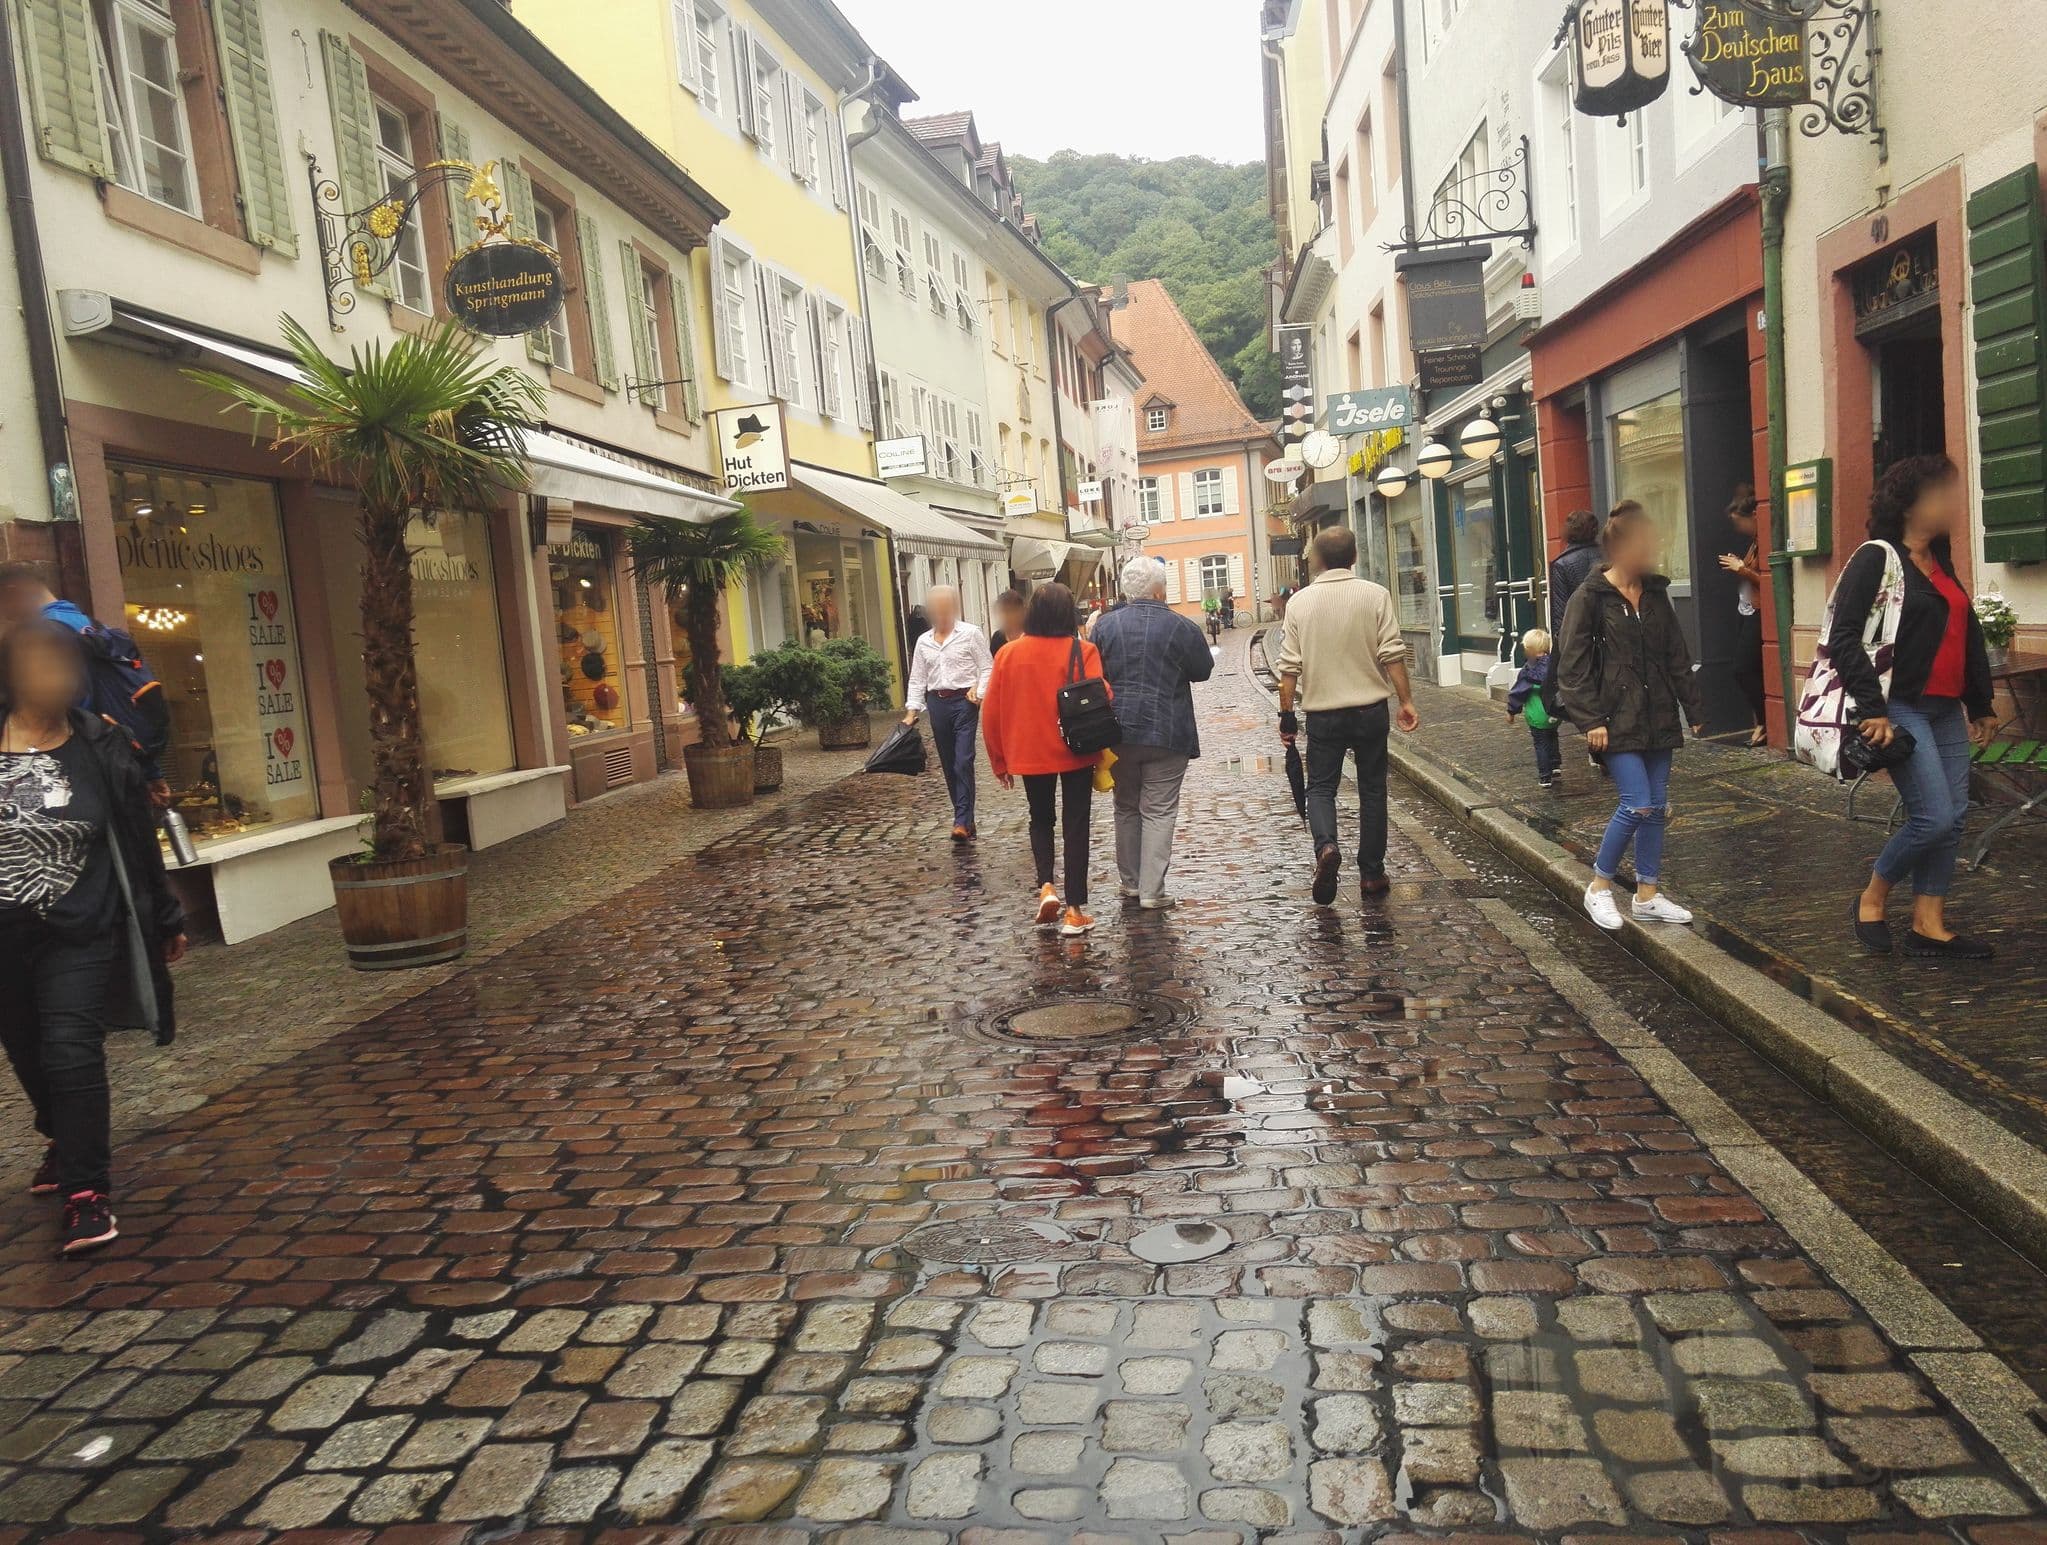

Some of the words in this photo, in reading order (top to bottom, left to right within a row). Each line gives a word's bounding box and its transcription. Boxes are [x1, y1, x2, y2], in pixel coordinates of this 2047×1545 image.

[1582, 7, 1622, 50] Ganter-
[1631, 0, 1664, 38] Ganter-
[1702, 5, 1745, 31] Zum
[1598, 32, 1622, 56] Pils
[1639, 32, 1663, 59] Bier
[1701, 26, 1799, 62] Deutschen
[1745, 57, 1804, 97] Haus
[455, 272, 553, 296] Kunsthandlung
[467, 289, 546, 312] Springmann
[725, 455, 753, 471] Hut
[726, 471, 785, 489] Dickten
[197, 533, 264, 575] shoes
[247, 592, 259, 621] I
[249, 624, 287, 646] SALE
[256, 663, 267, 690] I
[258, 692, 294, 715] SALE
[263, 732, 275, 759] I
[266, 759, 302, 785] SALE
